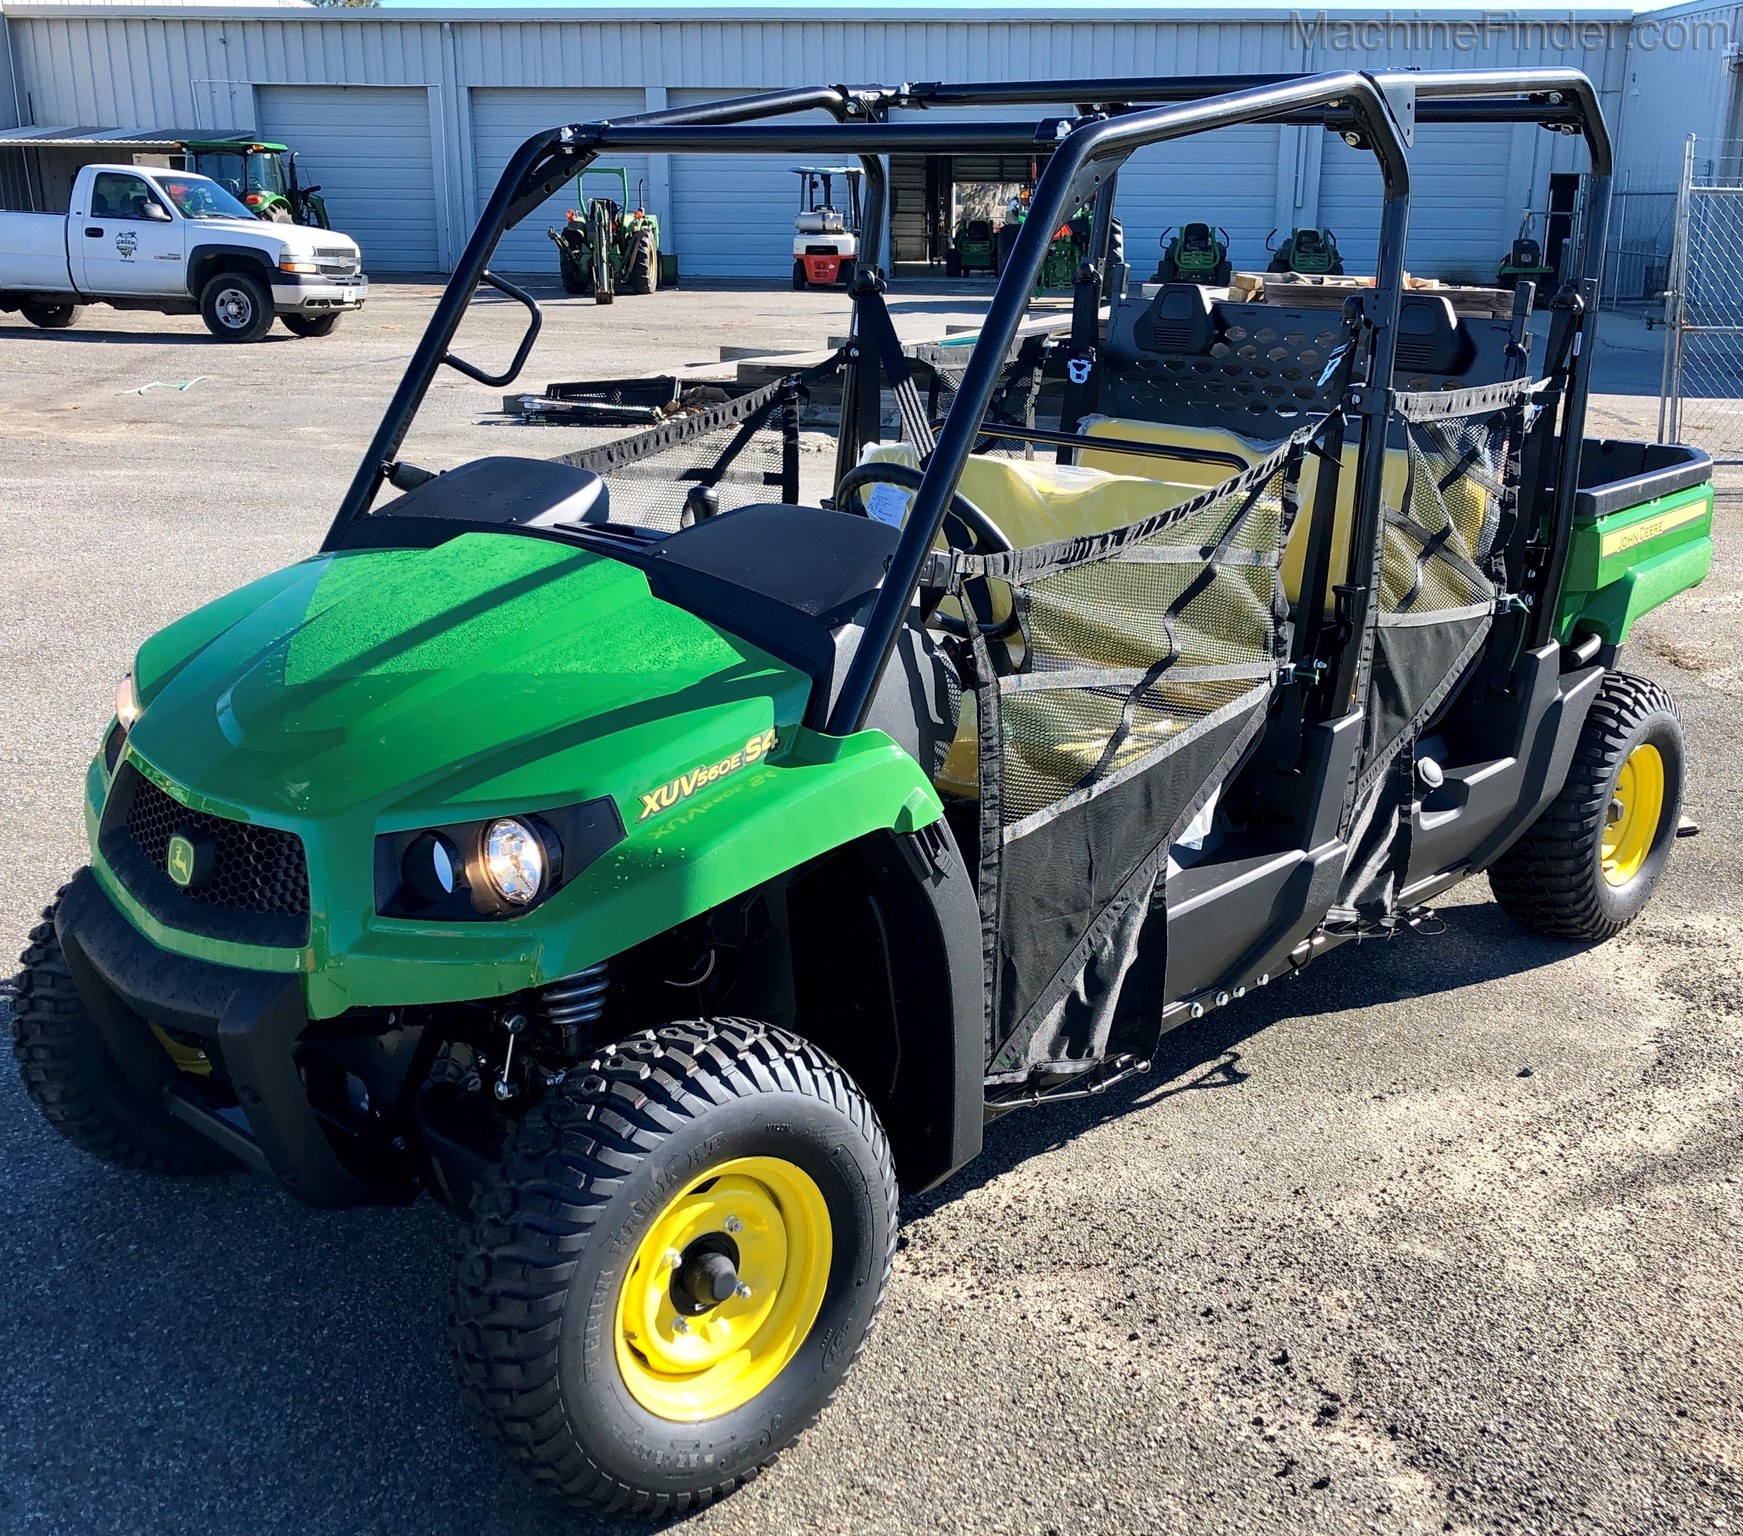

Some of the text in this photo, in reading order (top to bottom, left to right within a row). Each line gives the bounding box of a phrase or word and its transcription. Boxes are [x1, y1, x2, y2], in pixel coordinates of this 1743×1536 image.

[1618, 521, 1663, 551] JOHN DEERE
[638, 728, 778, 821] XUV560E S4
